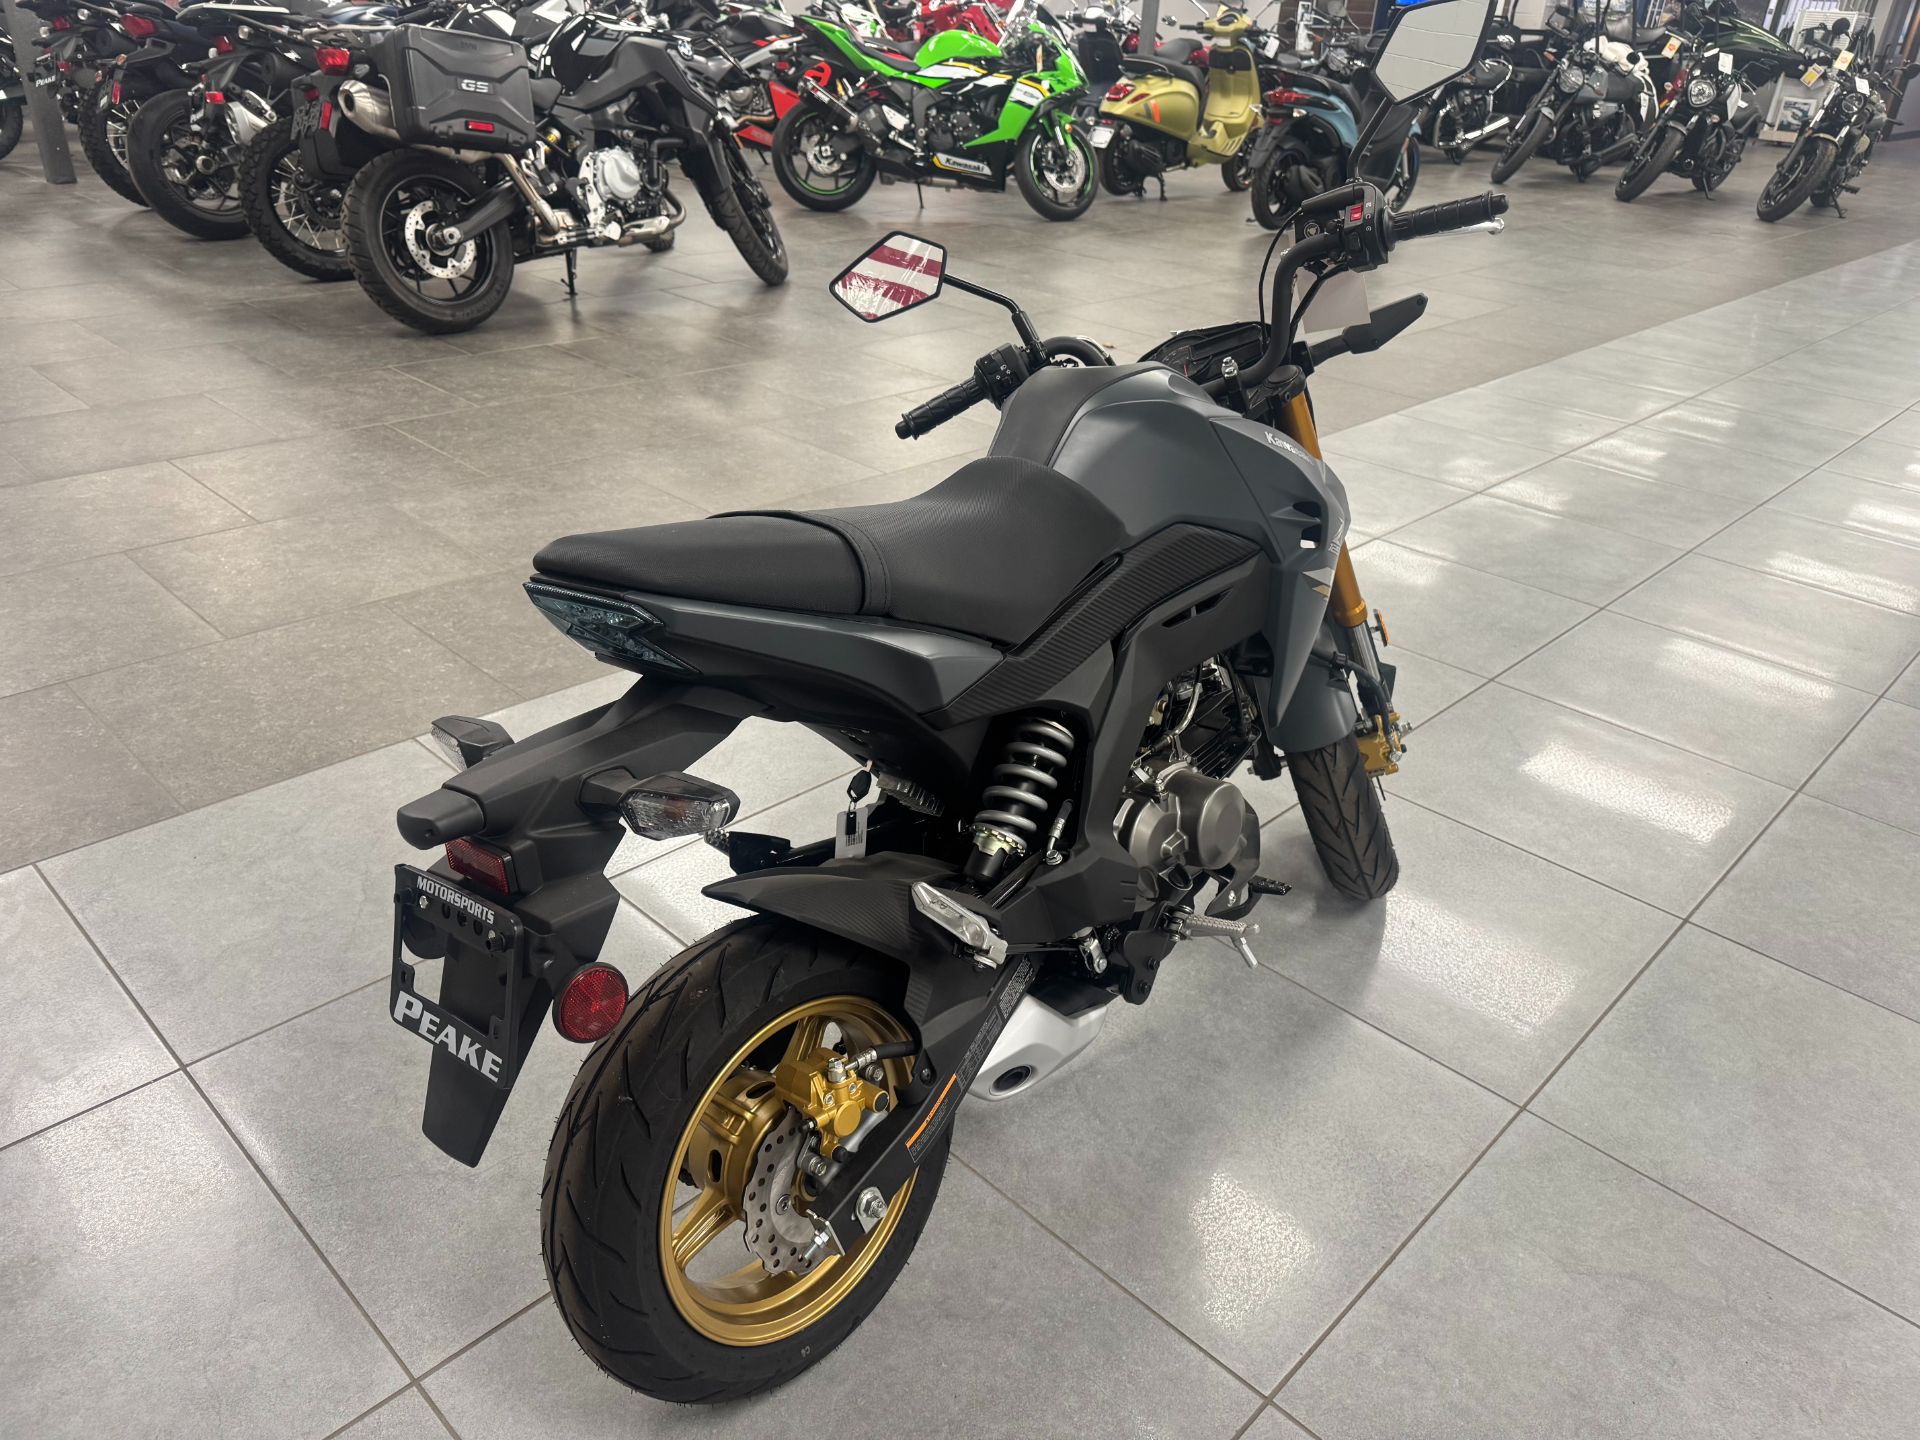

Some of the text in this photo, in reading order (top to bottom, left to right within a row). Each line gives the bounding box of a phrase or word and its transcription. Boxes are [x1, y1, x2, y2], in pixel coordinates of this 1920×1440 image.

[461, 78, 489, 93] GS
[946, 157, 985, 172] Kawasaki
[416, 875, 495, 925] MOTORSPORTS
[393, 990, 503, 1083] PEAKE
